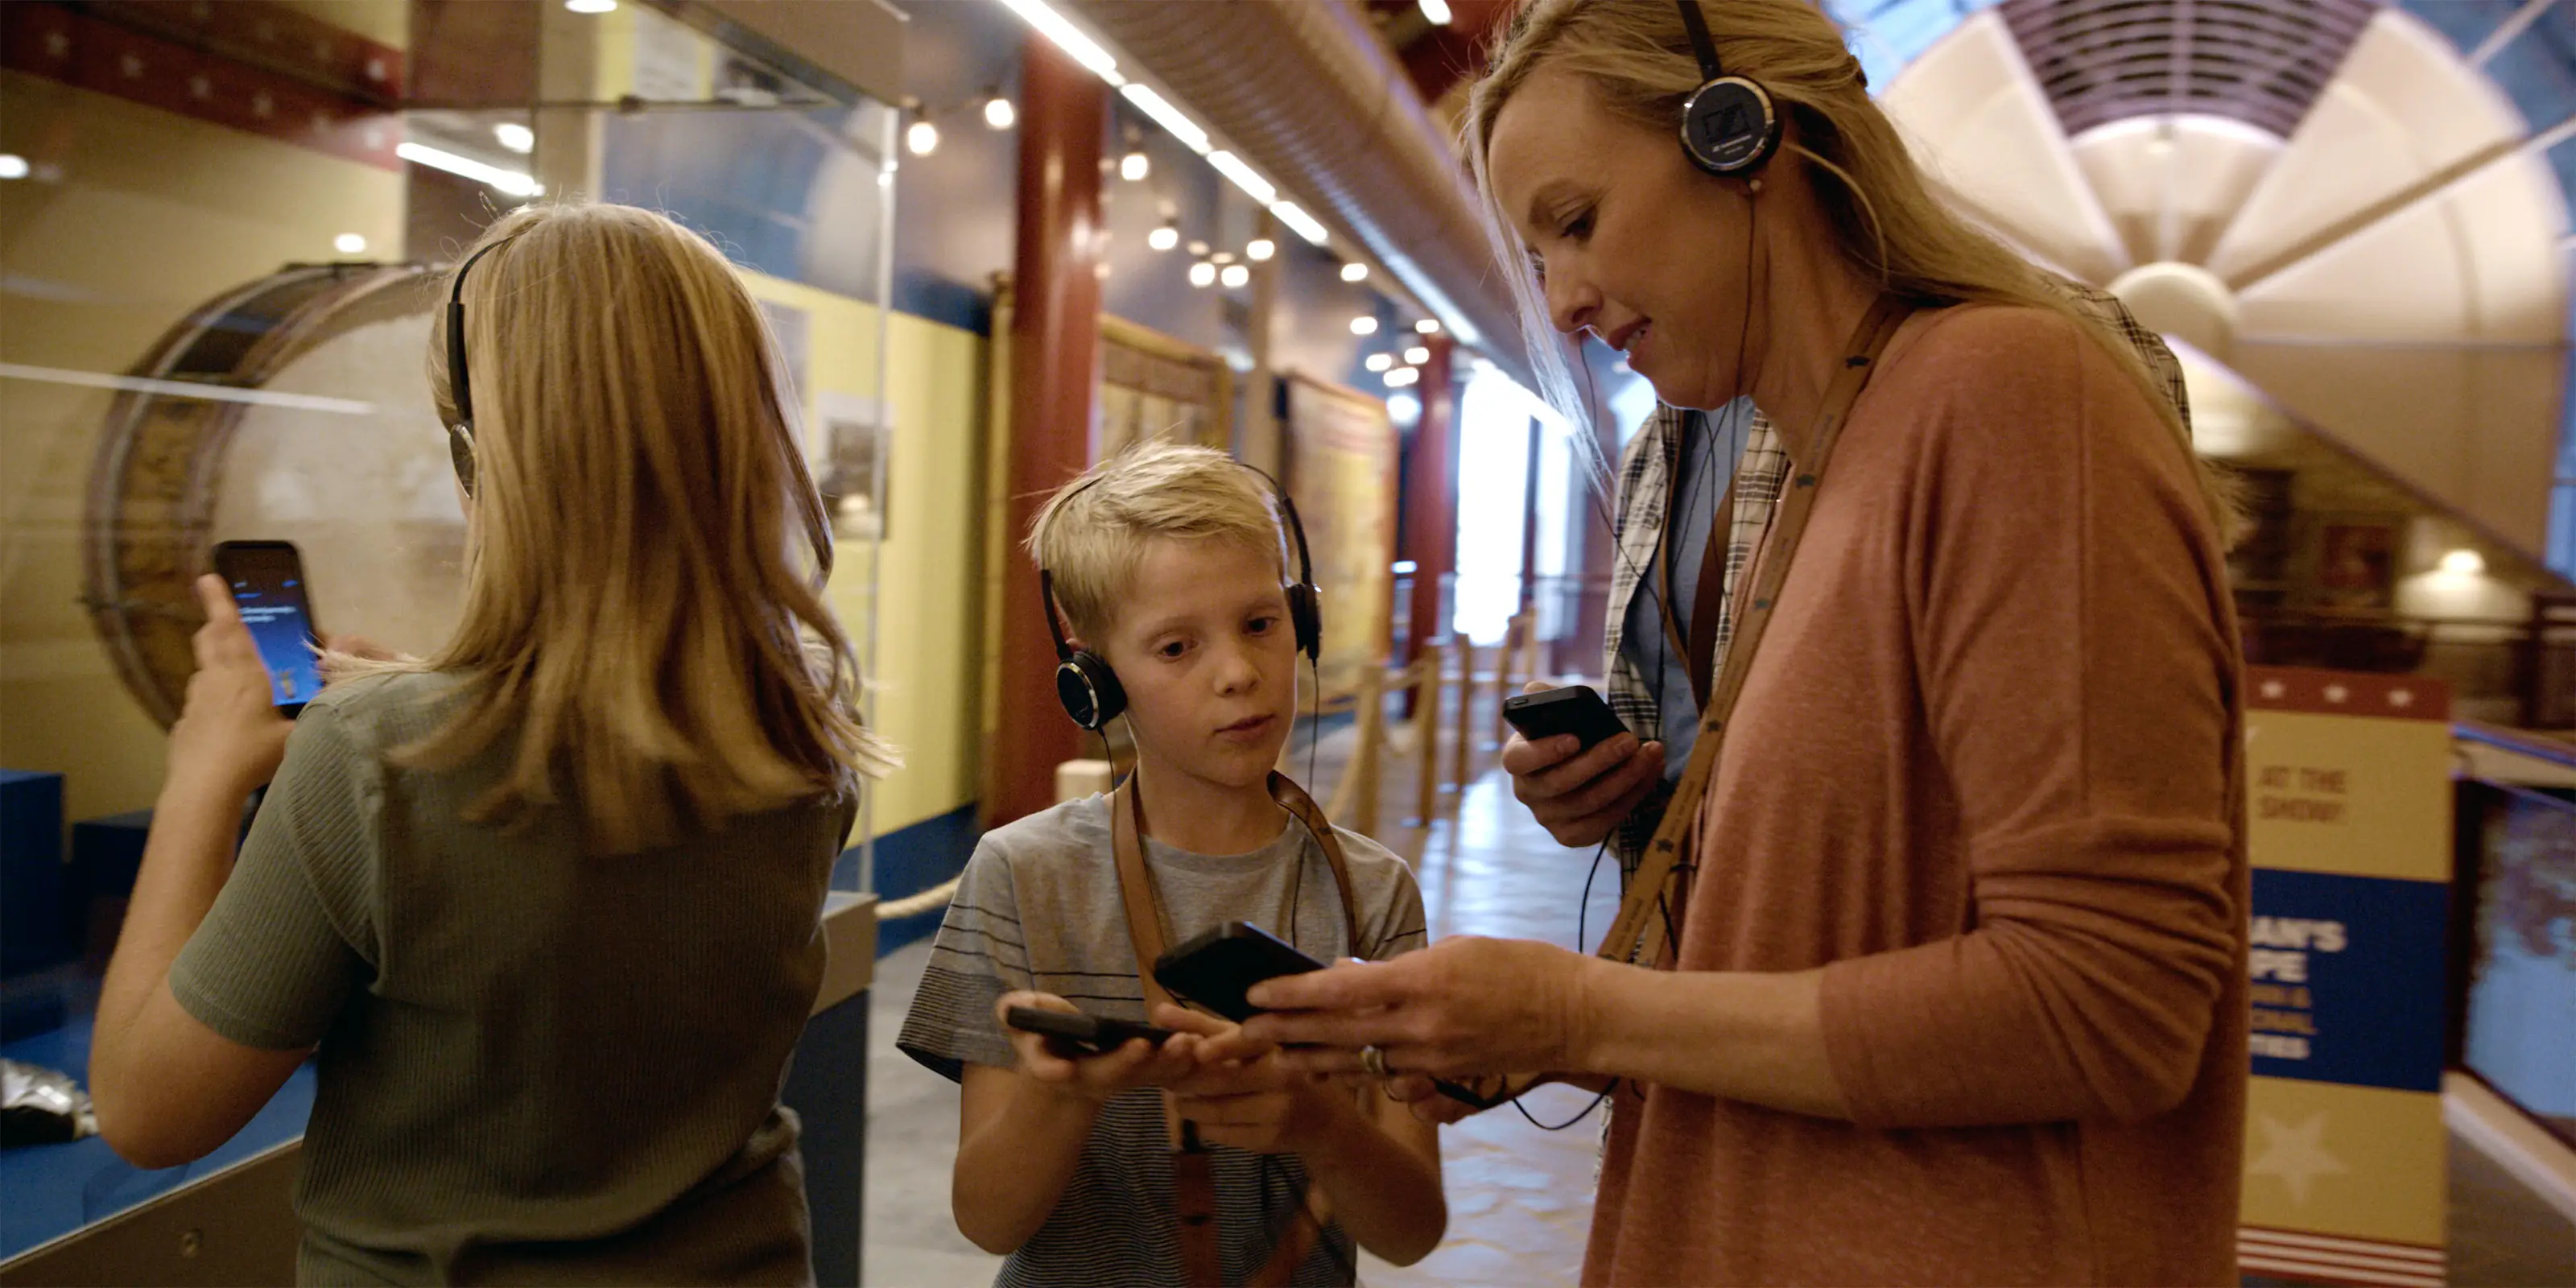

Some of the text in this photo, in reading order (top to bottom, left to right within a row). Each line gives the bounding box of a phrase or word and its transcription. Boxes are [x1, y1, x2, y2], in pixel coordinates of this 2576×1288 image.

[2256, 766, 2347, 794] AT THE
[2248, 915, 2347, 952] AN'S
[2248, 948, 2309, 983] PE
